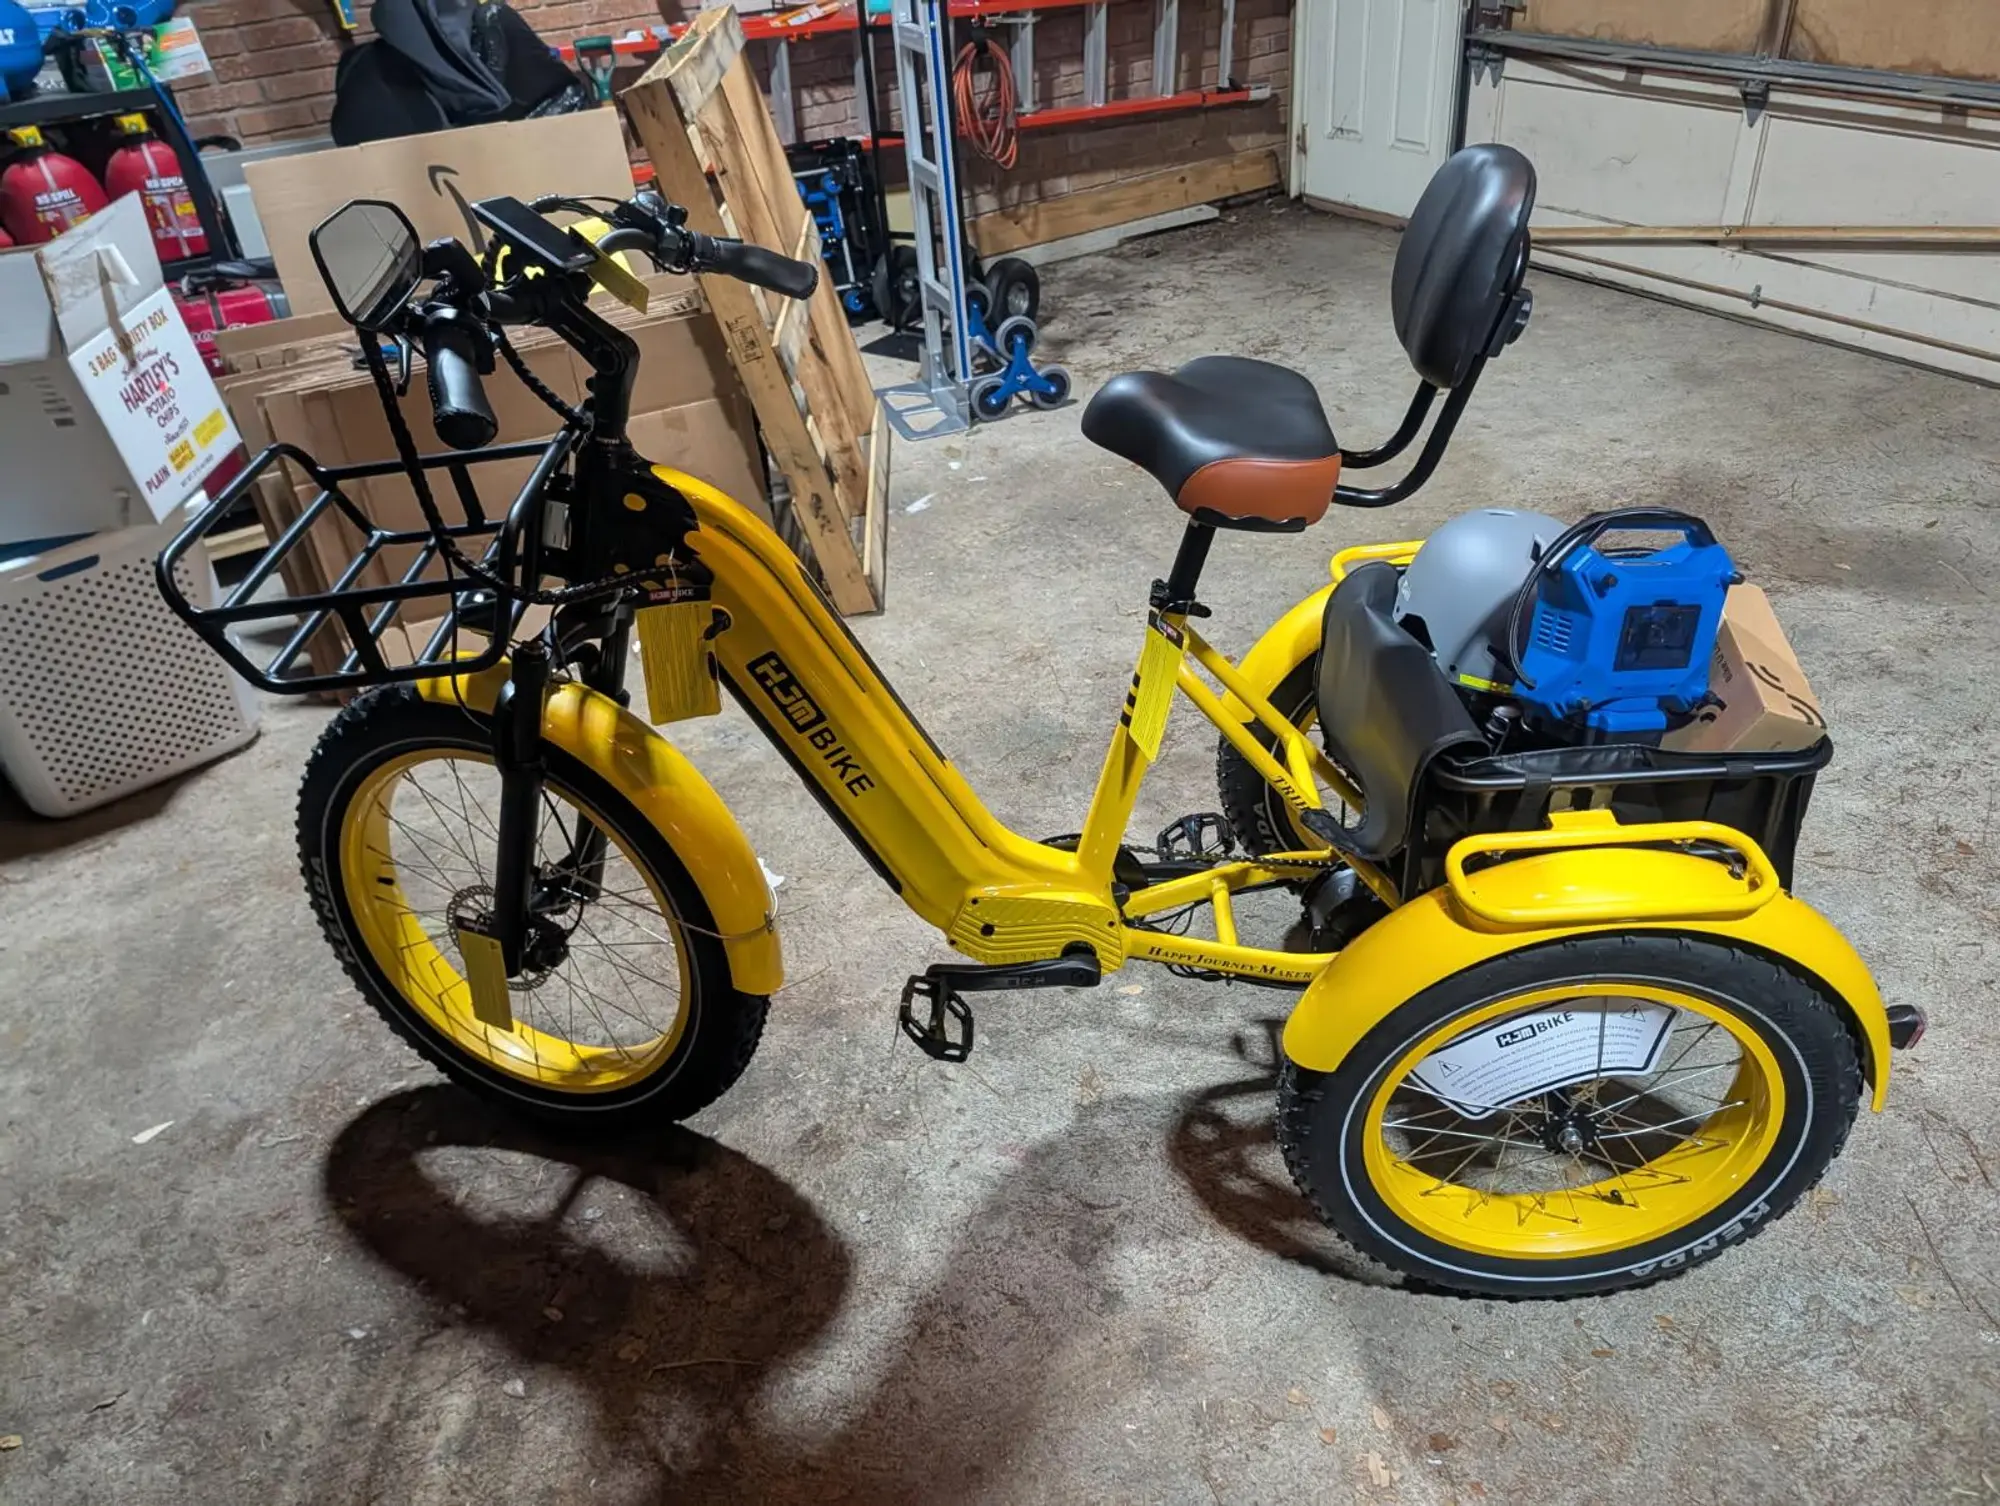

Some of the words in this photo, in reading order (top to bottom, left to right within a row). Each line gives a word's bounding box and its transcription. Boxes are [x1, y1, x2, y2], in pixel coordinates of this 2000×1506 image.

[88, 360, 99, 377] 3
[96, 346, 117, 371] BAG
[147, 306, 169, 331] BOX
[119, 351, 180, 414] HARTLEY'S
[145, 386, 177, 419] POTATO
[157, 402, 181, 428] CHIPS
[144, 464, 171, 494] PLAIN
[808, 729, 875, 797] BIKE
[1537, 1011, 1575, 1034] BIKE
[1630, 1200, 1771, 1277] KENDA
